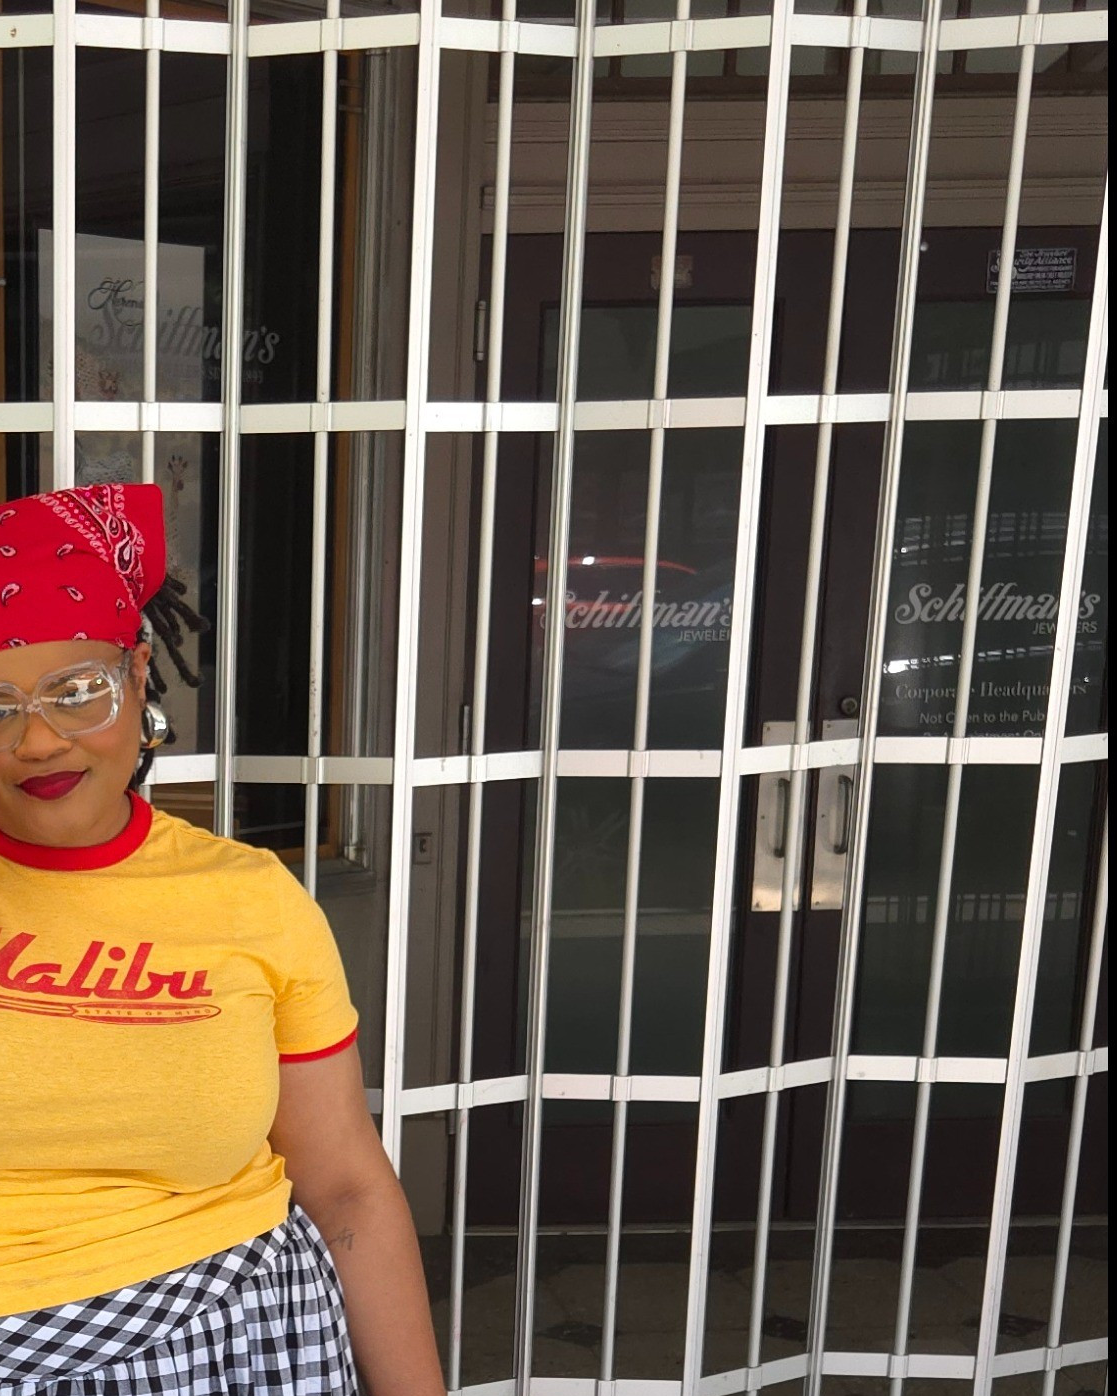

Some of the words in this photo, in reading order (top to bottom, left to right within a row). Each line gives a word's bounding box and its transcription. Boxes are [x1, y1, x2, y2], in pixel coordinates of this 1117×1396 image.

[894, 582, 1101, 625] Schffma's
[1033, 621, 1098, 635] JEWERS
[677, 629, 731, 643] JEWELE
[980, 681, 1087, 702] Headquars
[919, 713, 942, 725] Not
[945, 712, 980, 725] Oen
[984, 711, 996, 724] to
[999, 710, 1019, 723] the
